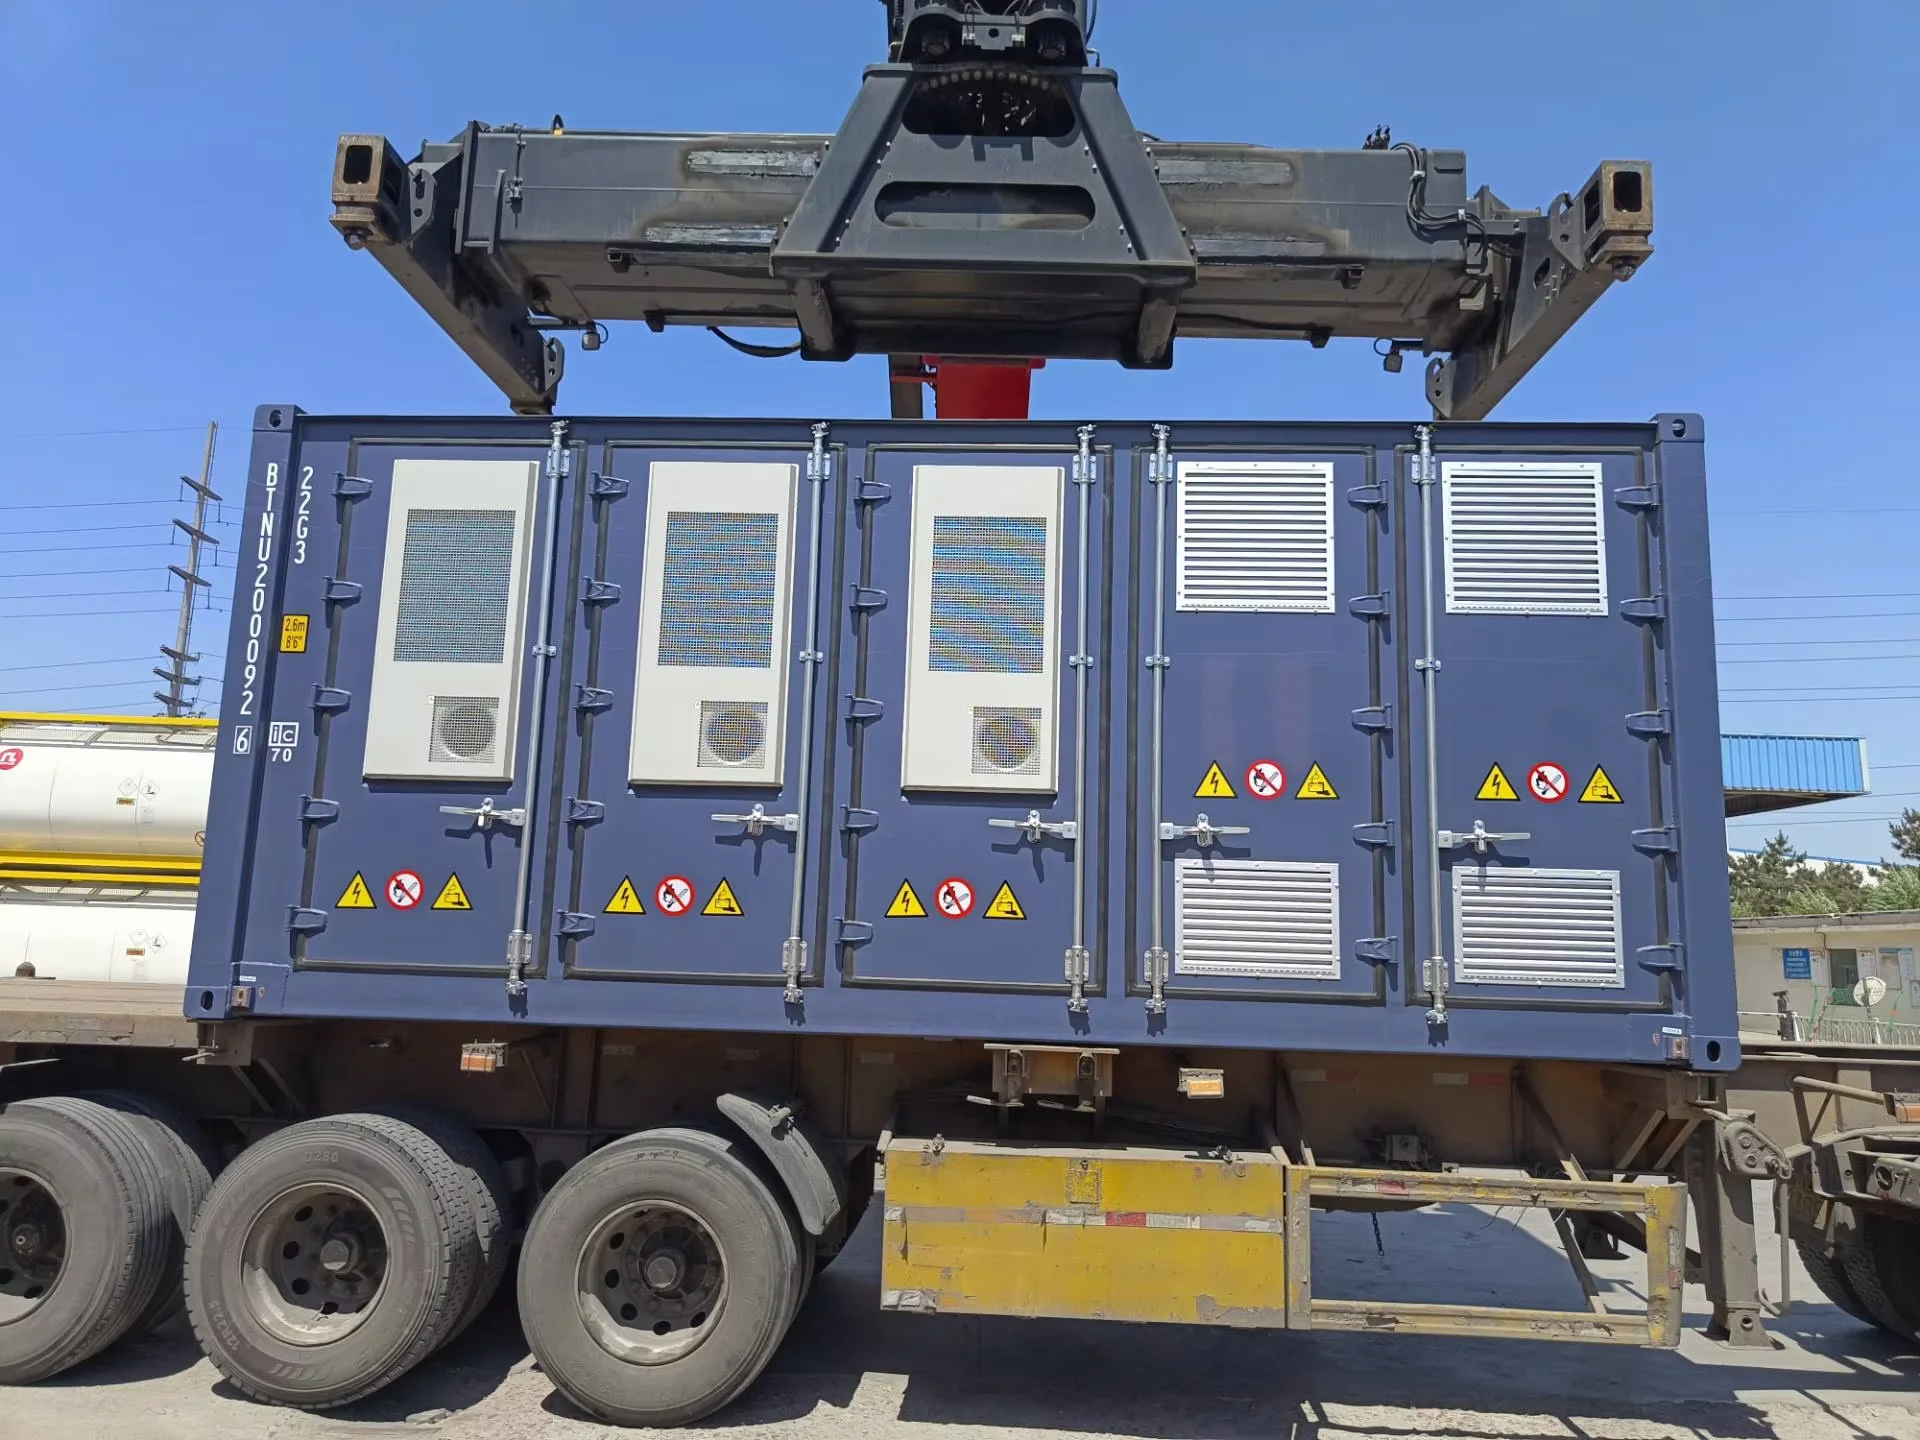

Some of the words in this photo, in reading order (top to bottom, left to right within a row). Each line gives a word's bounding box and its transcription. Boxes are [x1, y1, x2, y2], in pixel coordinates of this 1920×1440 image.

[293, 466, 314, 565] 22G3
[285, 618, 305, 632] 2.6m
[236, 728, 249, 752] 6
[271, 747, 293, 763] 70
